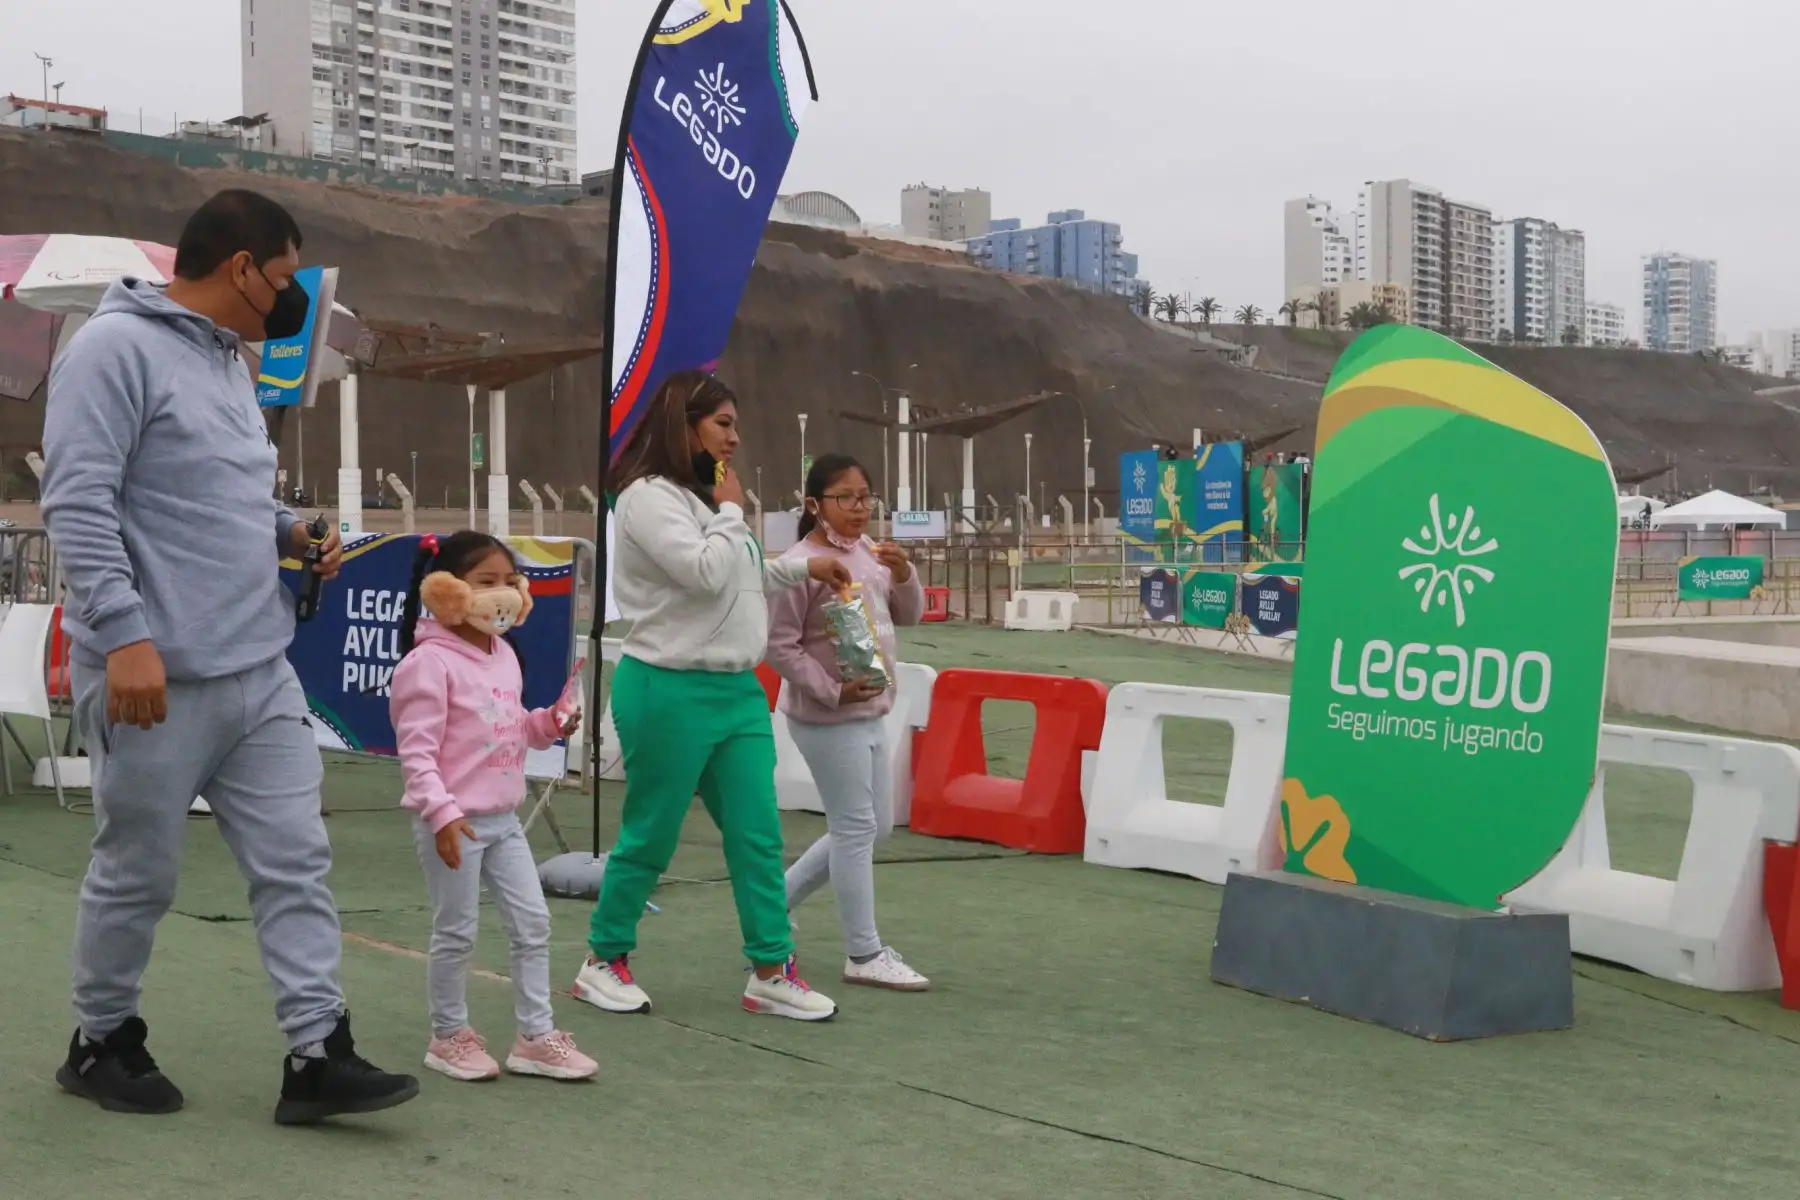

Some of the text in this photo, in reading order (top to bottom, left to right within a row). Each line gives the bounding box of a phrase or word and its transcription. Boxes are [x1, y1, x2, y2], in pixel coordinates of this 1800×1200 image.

[270, 344, 304, 359] Talleres
[900, 512, 929, 522] SALIDA
[343, 625, 402, 661] AYLL
[342, 661, 395, 698] PUK
[1327, 703, 1543, 755] Seguimos jugando
